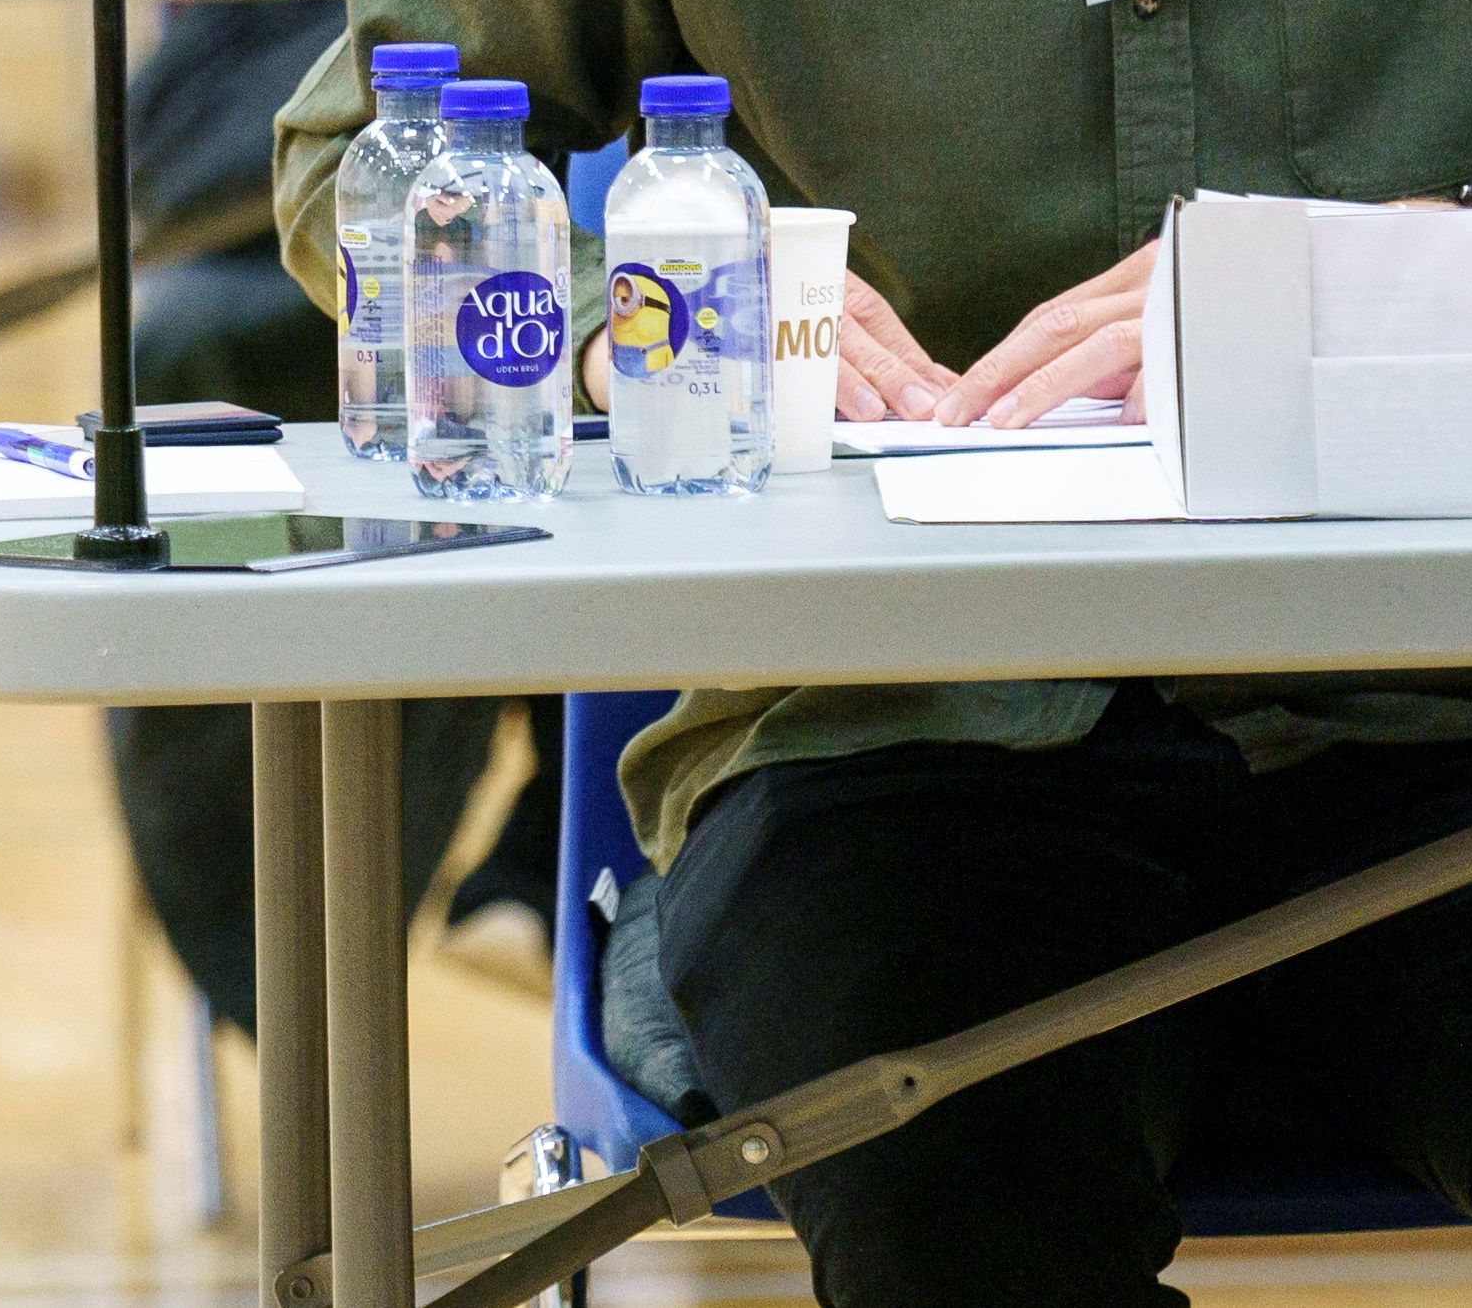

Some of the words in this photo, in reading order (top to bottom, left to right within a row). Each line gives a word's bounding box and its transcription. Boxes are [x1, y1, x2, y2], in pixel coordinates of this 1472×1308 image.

[801, 281, 834, 306] less
[460, 287, 555, 328] Aqua
[689, 382, 710, 396] 0,3
[714, 381, 722, 394] L
